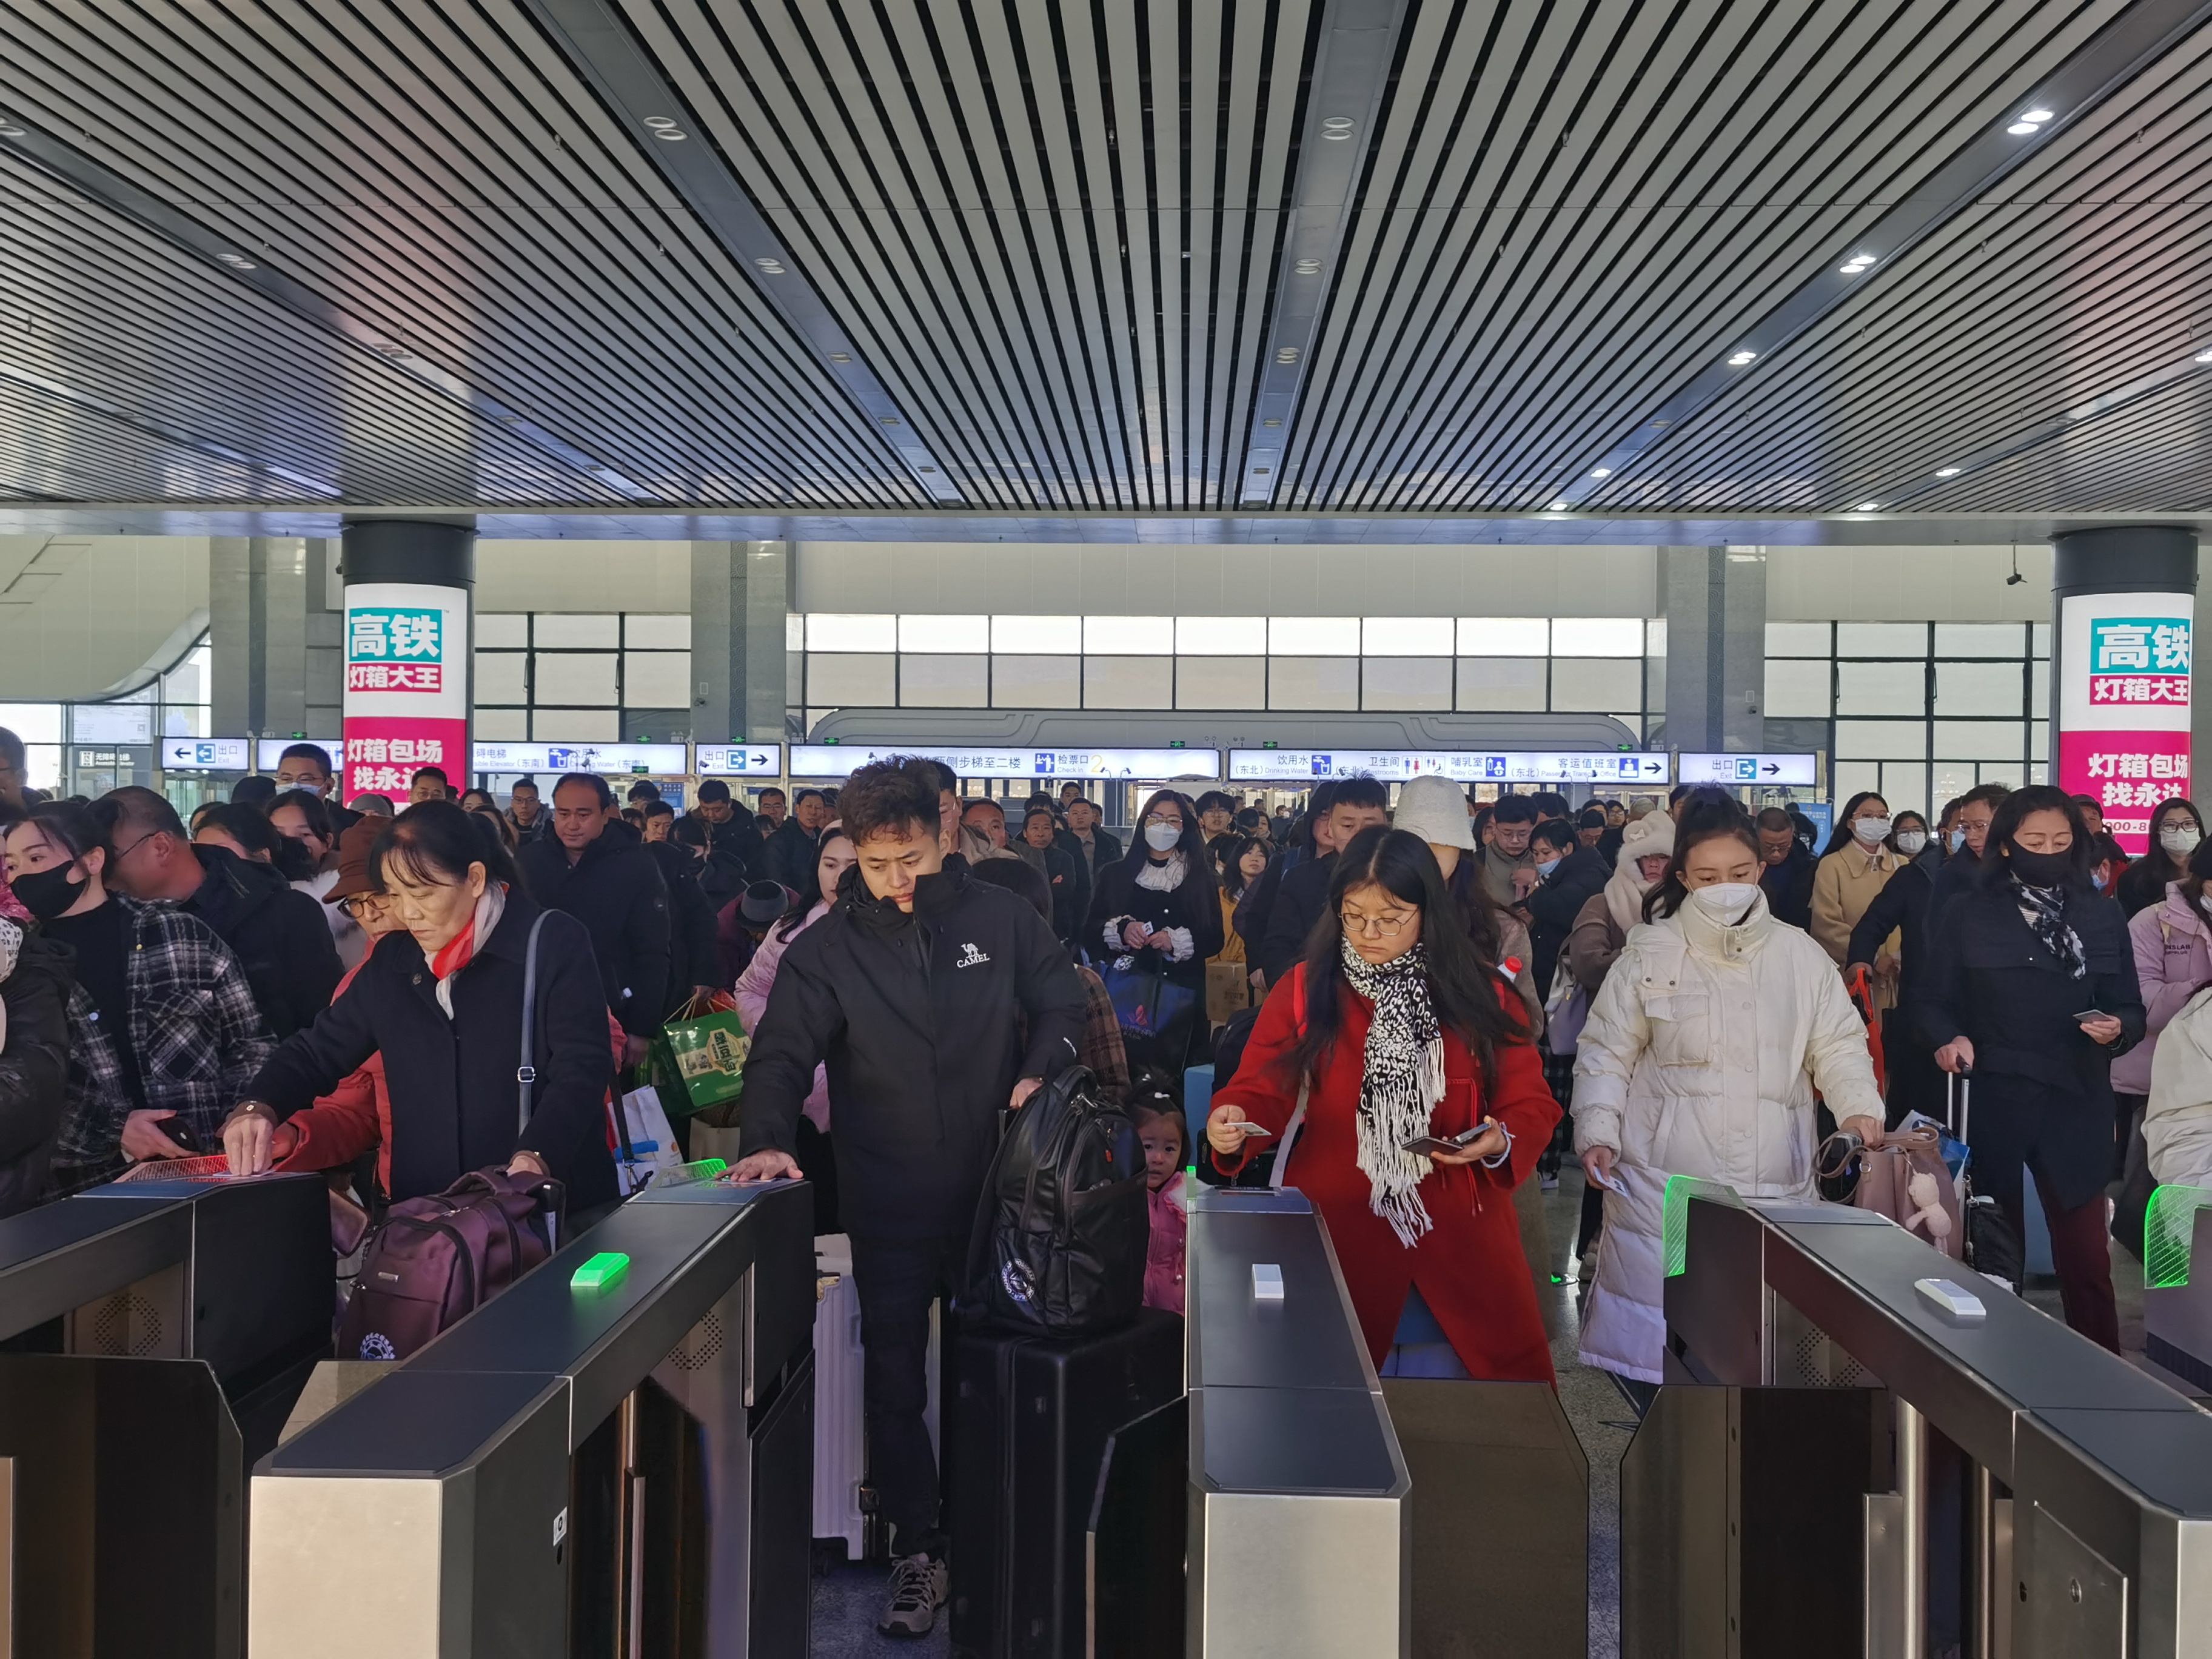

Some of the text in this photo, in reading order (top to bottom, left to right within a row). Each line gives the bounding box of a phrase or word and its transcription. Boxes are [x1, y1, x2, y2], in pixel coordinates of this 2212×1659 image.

[350, 614, 440, 657] 高铁
[2097, 624, 2189, 669] 高铁
[349, 665, 440, 689] 灯箱大王
[2094, 678, 2188, 702] 灯箱大王
[218, 745, 237, 755] 出口
[347, 738, 443, 763] 灯箱包场
[476, 748, 506, 759] 碍电梯
[705, 750, 724, 760] 出口
[517, 759, 545, 768] (东南)
[1057, 754, 1088, 764] 检票口
[1090, 754, 1103, 773] 2
[1277, 754, 1309, 765] 饮用水
[1368, 756, 1400, 767] 卫生间
[1451, 757, 1483, 768] 哺乳室
[1558, 758, 1617, 768] 客运值班室
[1712, 759, 1733, 770] 出口
[1235, 765, 1263, 775] (东北)
[2087, 753, 2188, 779] 灯箱包场
[1511, 767, 1540, 778] (东北)
[956, 953, 990, 968] CAMEL
